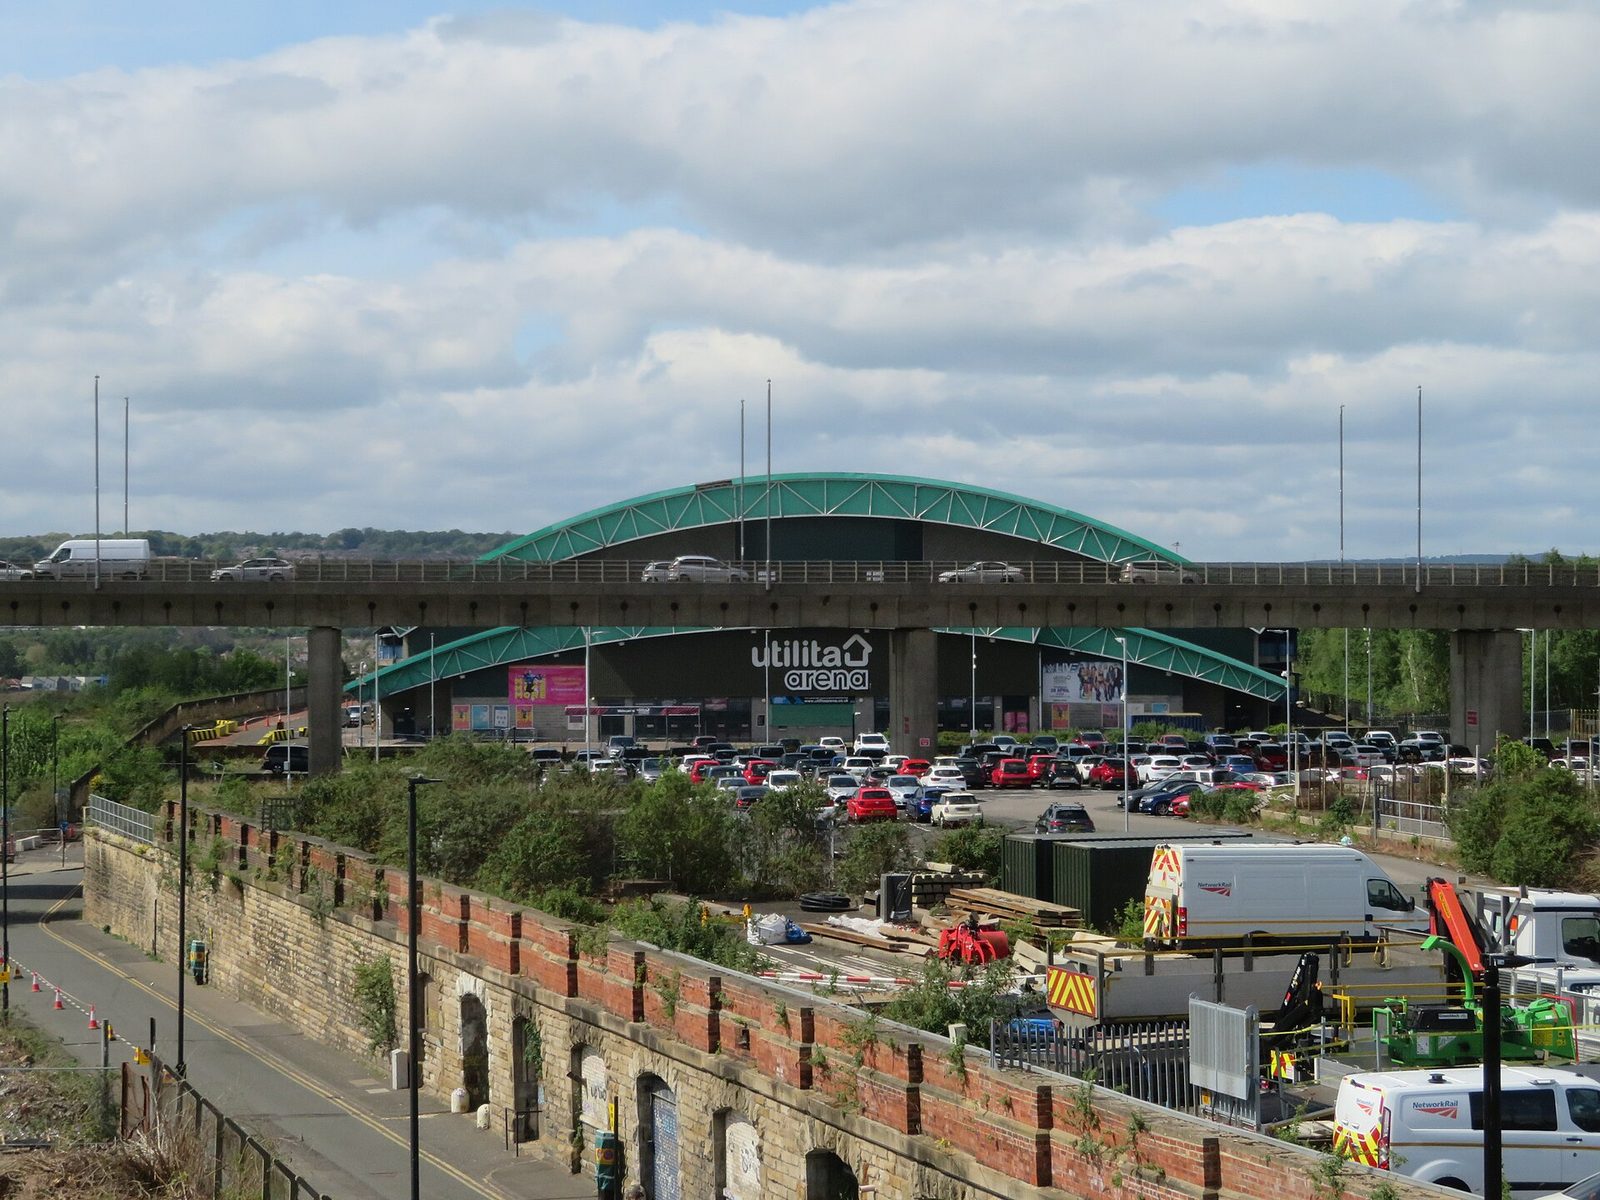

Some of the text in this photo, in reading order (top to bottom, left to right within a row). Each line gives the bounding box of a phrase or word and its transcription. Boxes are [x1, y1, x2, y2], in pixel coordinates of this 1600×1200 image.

[752, 640, 842, 667] utilita
[784, 669, 868, 690] arena
[1412, 1100, 1459, 1108] NetworkRail
